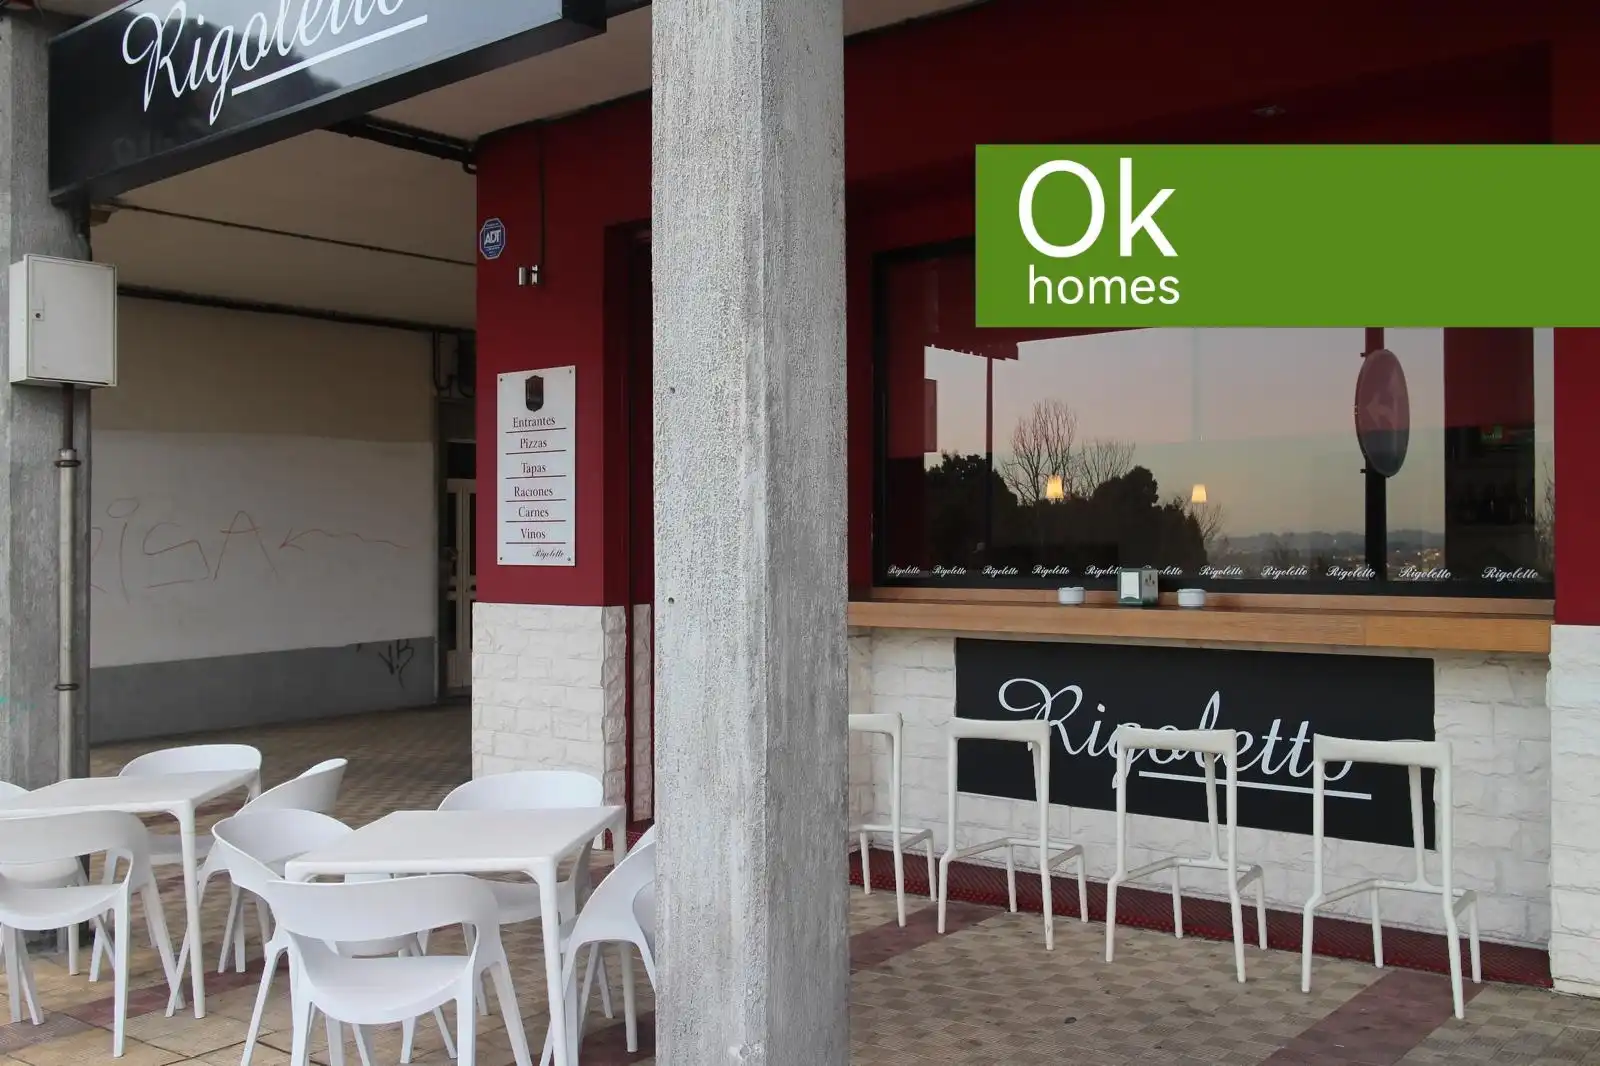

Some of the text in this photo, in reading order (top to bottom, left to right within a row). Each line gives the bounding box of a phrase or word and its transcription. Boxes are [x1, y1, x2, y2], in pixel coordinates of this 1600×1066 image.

[122, 0, 404, 125] Rigole
[484, 230, 502, 246] ADT
[512, 416, 556, 428] Entrantes
[519, 437, 548, 449] Pizzas
[520, 462, 547, 477] Tapas
[514, 486, 554, 497] Raciones
[518, 506, 550, 518] Carnes
[520, 527, 546, 540] Vinos
[887, 564, 921, 576] Rigoletto
[931, 564, 967, 576] Rigoletto
[981, 564, 1019, 577] Rigoletto
[1031, 564, 1070, 577] Rigoletto
[1084, 564, 1121, 578] Rigolet
[1198, 564, 1244, 579] Rigoletto
[1260, 564, 1308, 579] Rigoletto
[1326, 565, 1376, 580] Rigoletto
[1398, 565, 1452, 580] Rigoletto
[1481, 566, 1538, 582] Rigoletto
